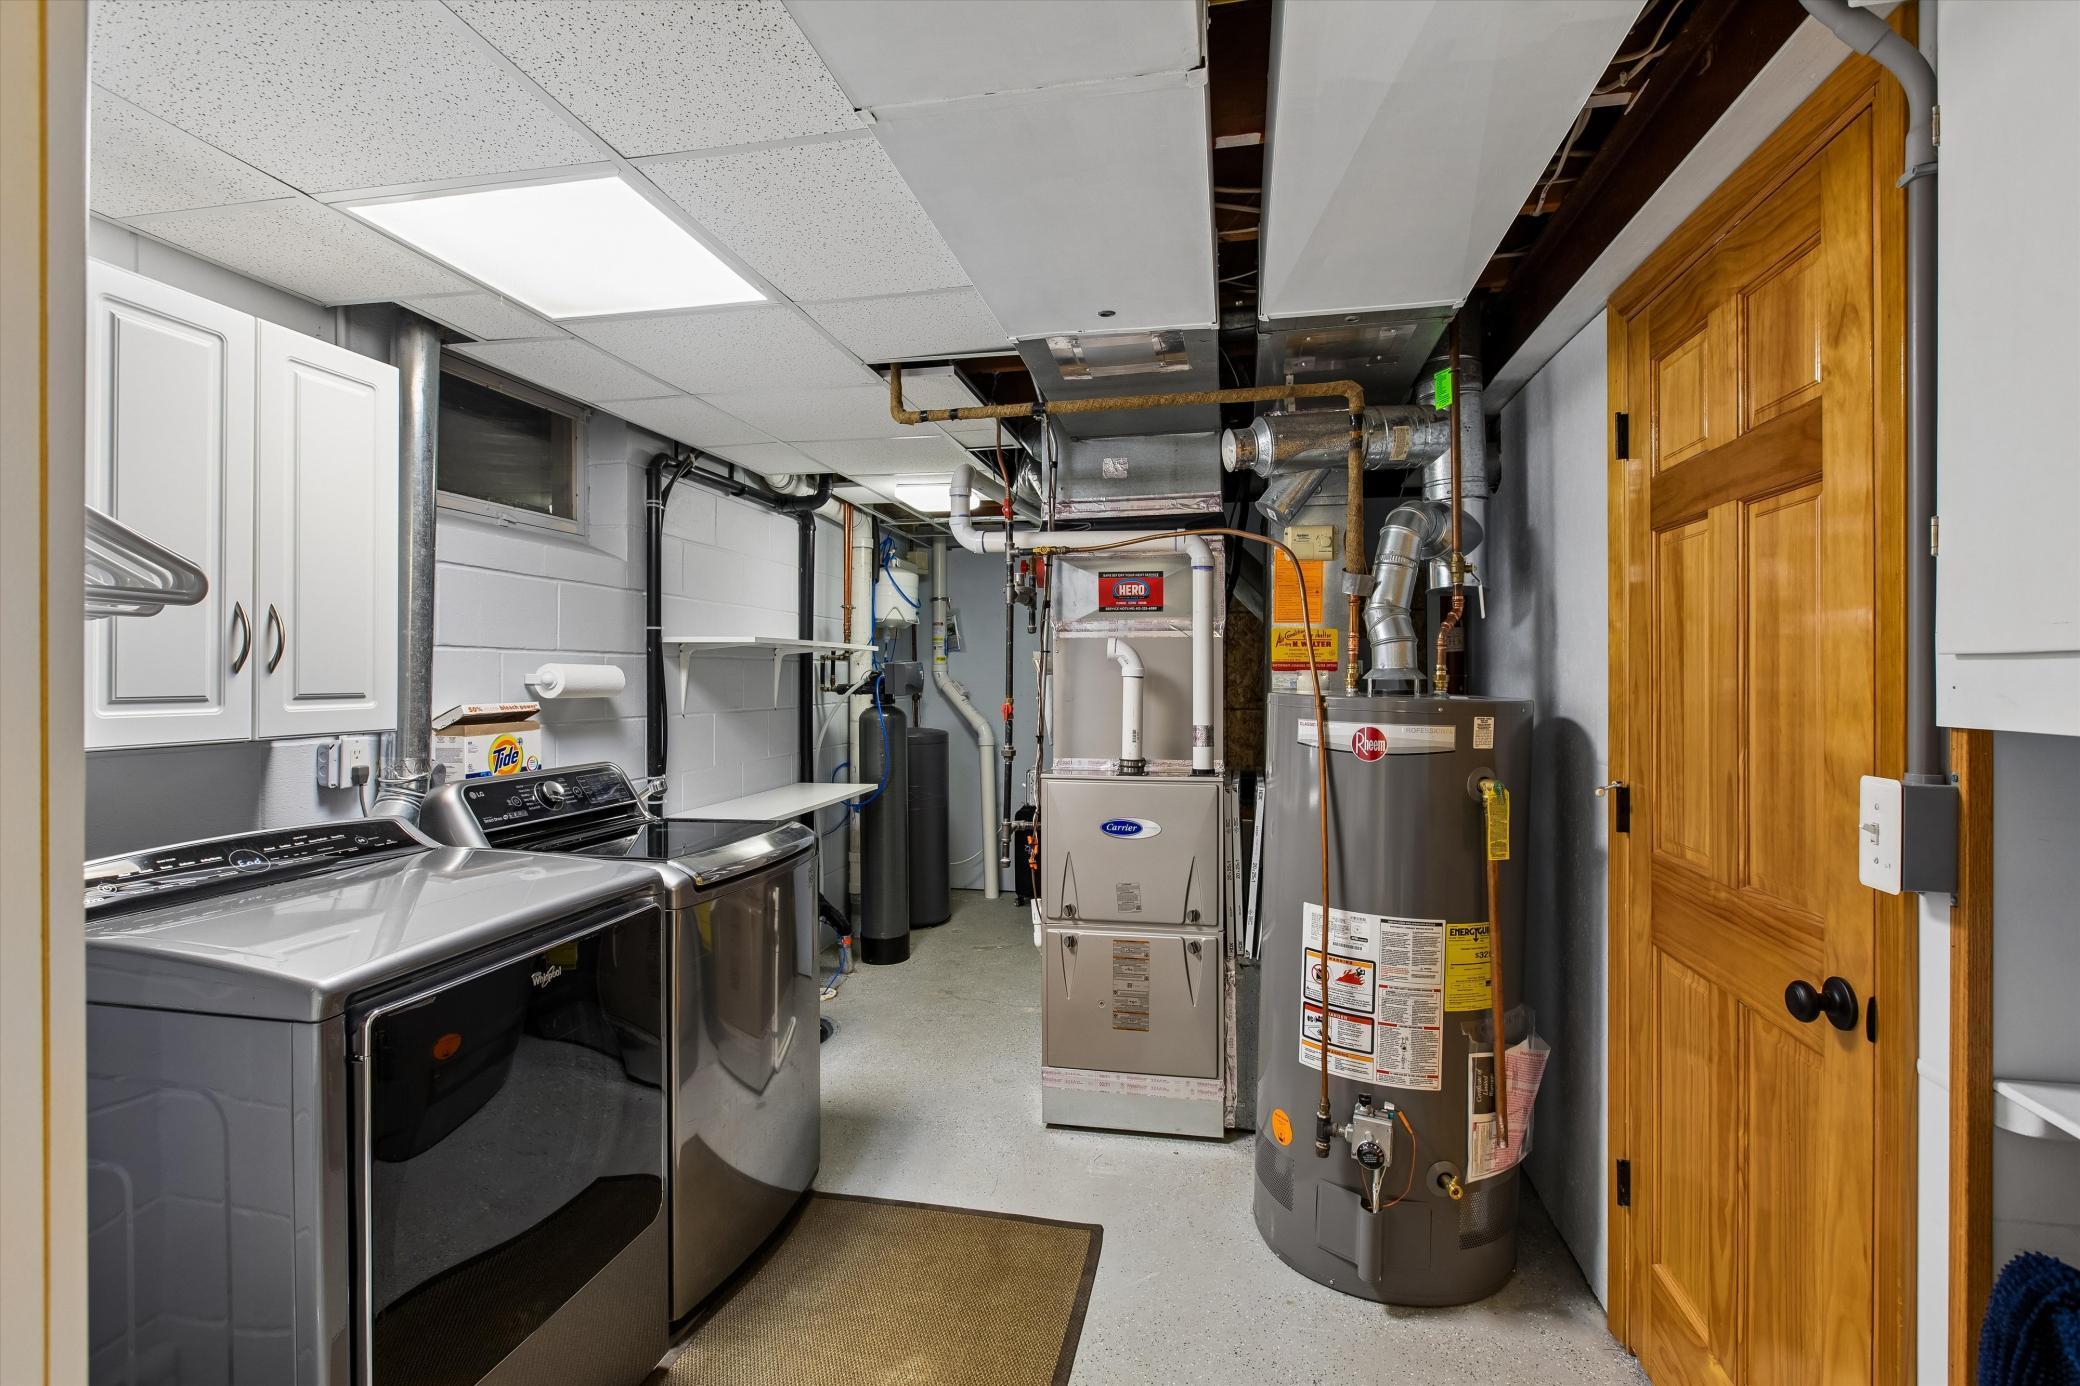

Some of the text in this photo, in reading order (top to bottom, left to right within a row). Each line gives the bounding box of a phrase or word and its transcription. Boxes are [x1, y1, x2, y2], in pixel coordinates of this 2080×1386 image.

[1119, 584, 1145, 596] HERO
[1401, 727, 1454, 735] PROFESSIONAL
[1355, 727, 1386, 756] Rheem
[493, 745, 519, 774] Tide
[1106, 823, 1138, 832] Carrier
[1450, 926, 1489, 936] ENERGYGUI
[531, 965, 562, 988] Whirlpool
